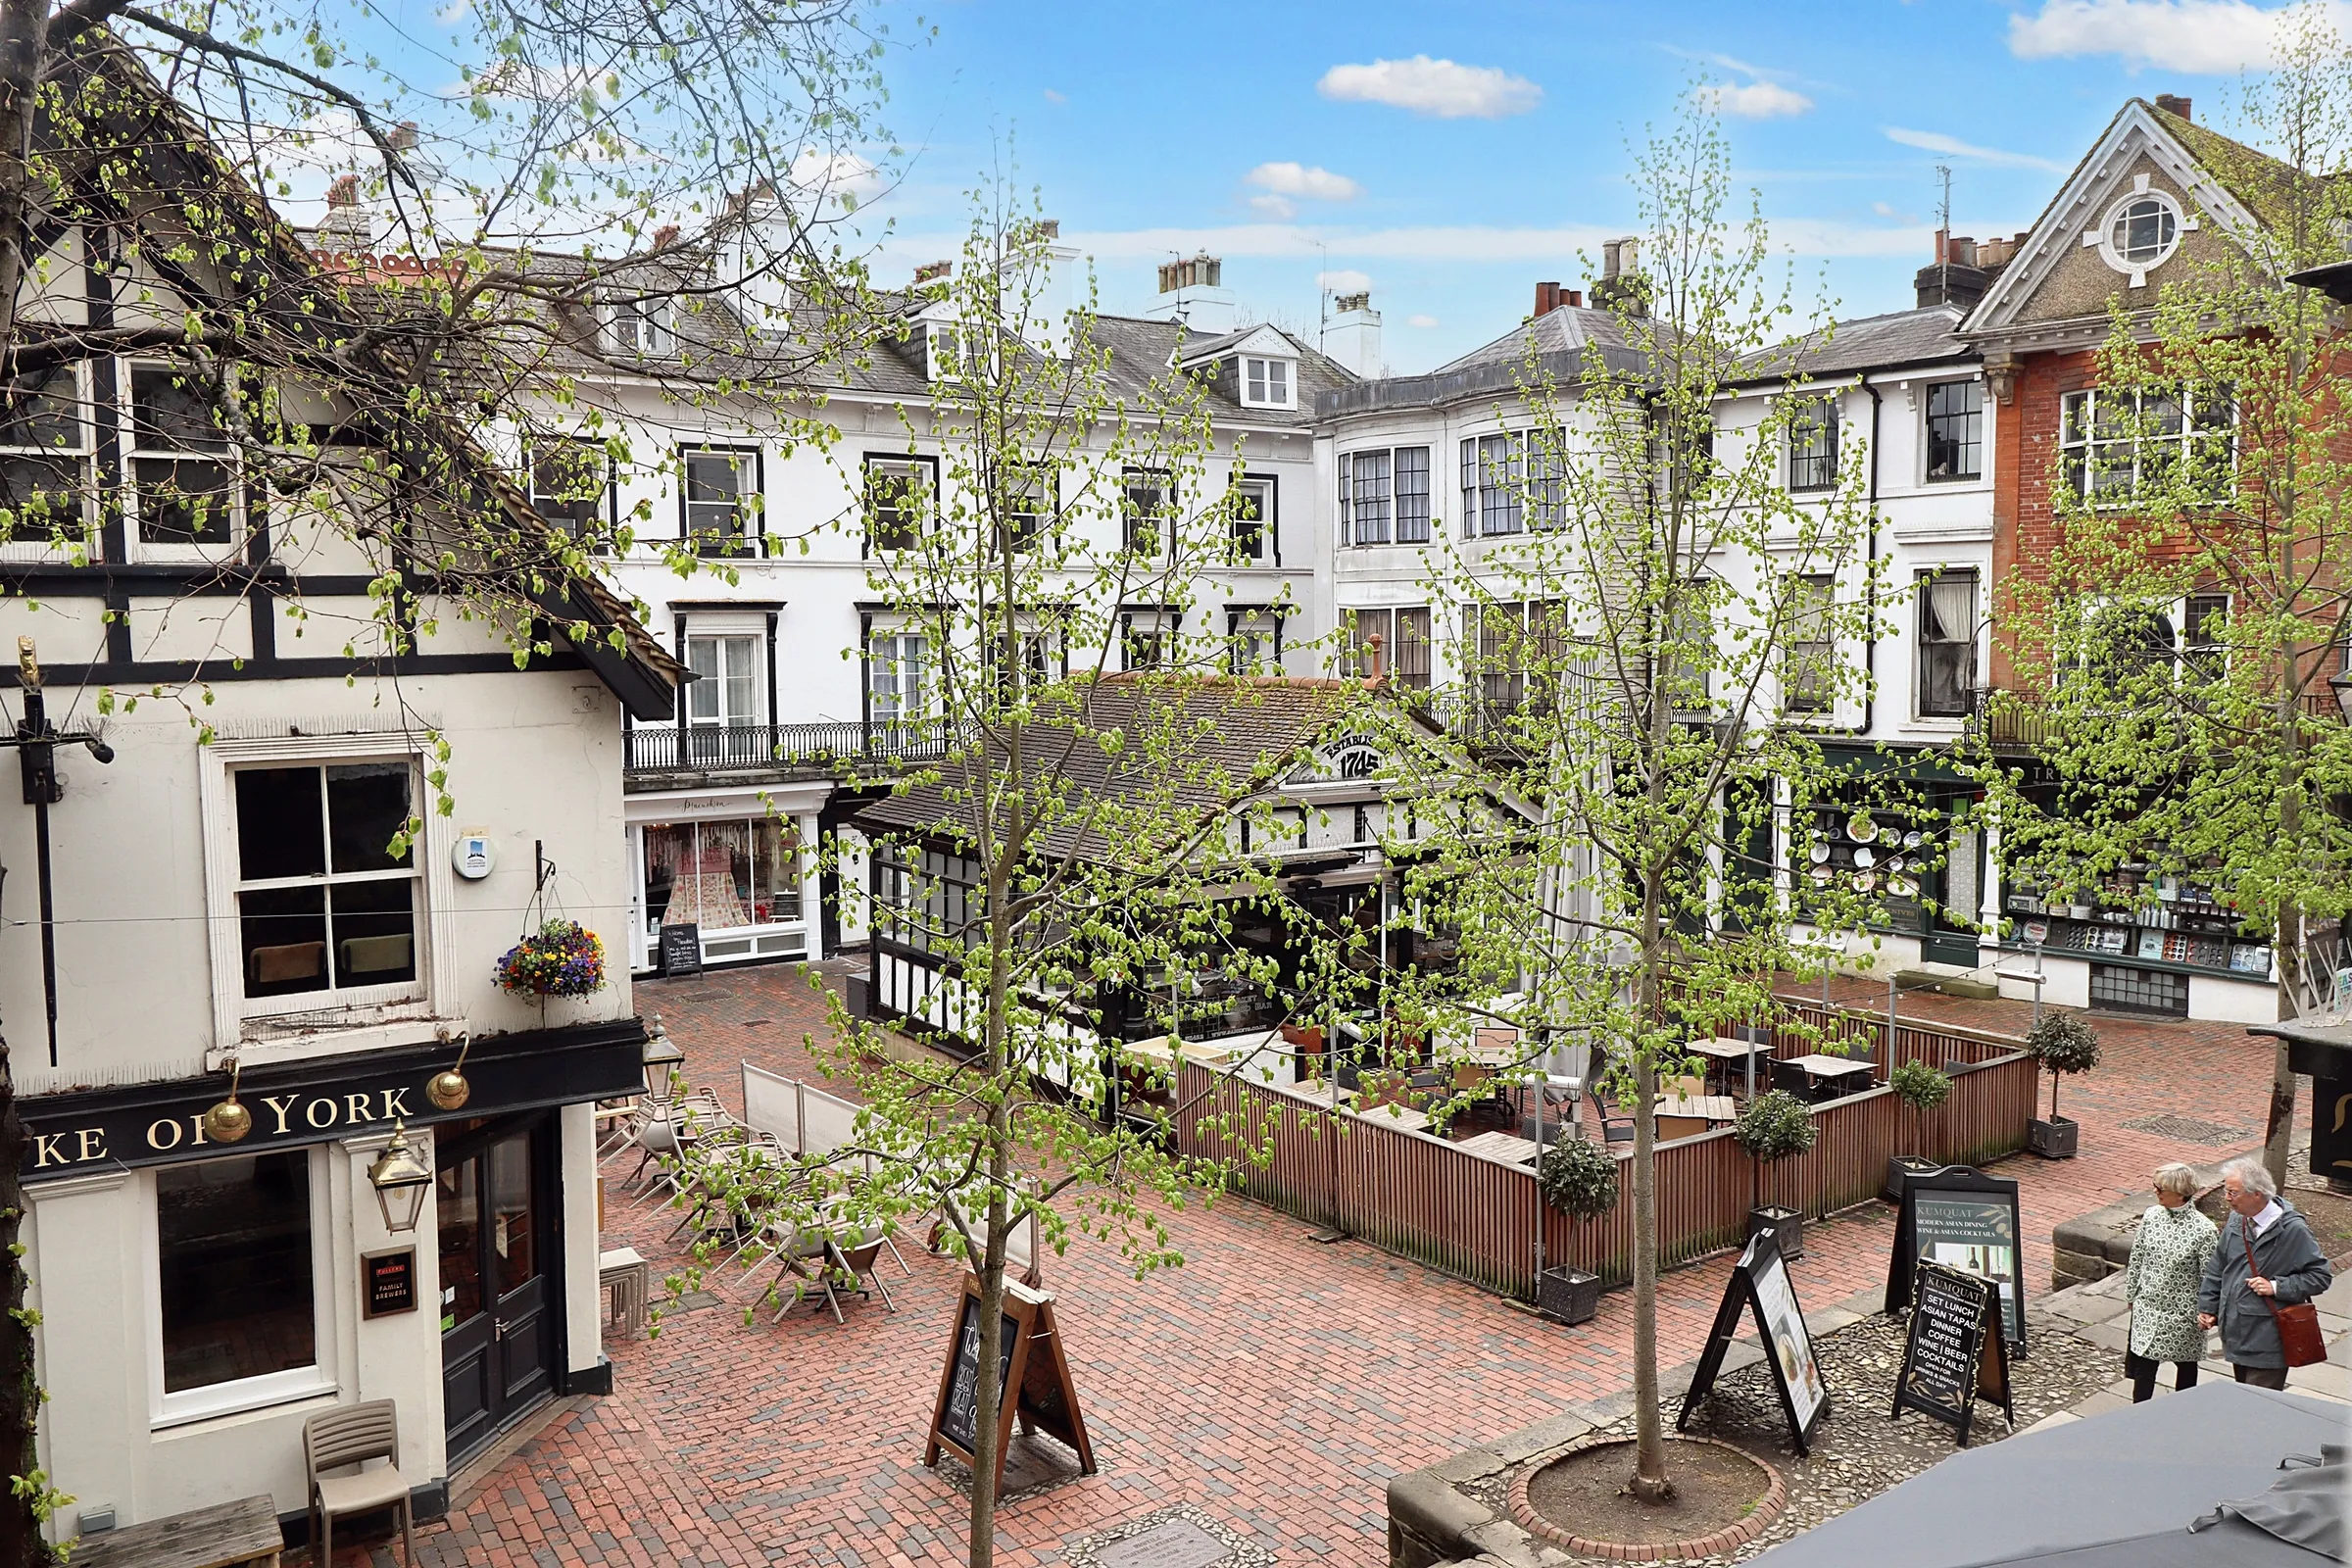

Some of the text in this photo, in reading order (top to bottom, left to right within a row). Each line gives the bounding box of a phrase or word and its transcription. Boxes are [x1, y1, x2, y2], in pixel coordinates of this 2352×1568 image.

[1327, 735, 1390, 760] ESTABLIS
[1340, 751, 1379, 778] 1745
[1254, 1002, 1272, 1010] BAR
[33, 1128, 109, 1168] KE
[261, 1087, 414, 1134] YORK
[1917, 1206, 1974, 1218] KUMQUAT
[375, 1289, 407, 1300] BREWERS
[379, 1282, 403, 1292] FAMILY
[968, 1278, 979, 1291] THE
[1927, 1276, 1981, 1301] KUMQUAT
[1927, 1295, 1975, 1317] SET LUNCH
[1921, 1304, 1977, 1330] ASIAN TAPAS
[1931, 1318, 1962, 1337] DINNER
[1928, 1329, 1961, 1348] COFFEE
[1918, 1336, 1938, 1351] WINE
[1944, 1347, 1968, 1362] BEER
[1917, 1348, 1965, 1373] COCKTAILS
[1925, 1361, 1951, 1376] OPEN FOR
[1914, 1365, 1934, 1377] DRINKS
[1938, 1374, 1960, 1388] SNACKS
[1925, 1377, 1947, 1390] ALL DAY
